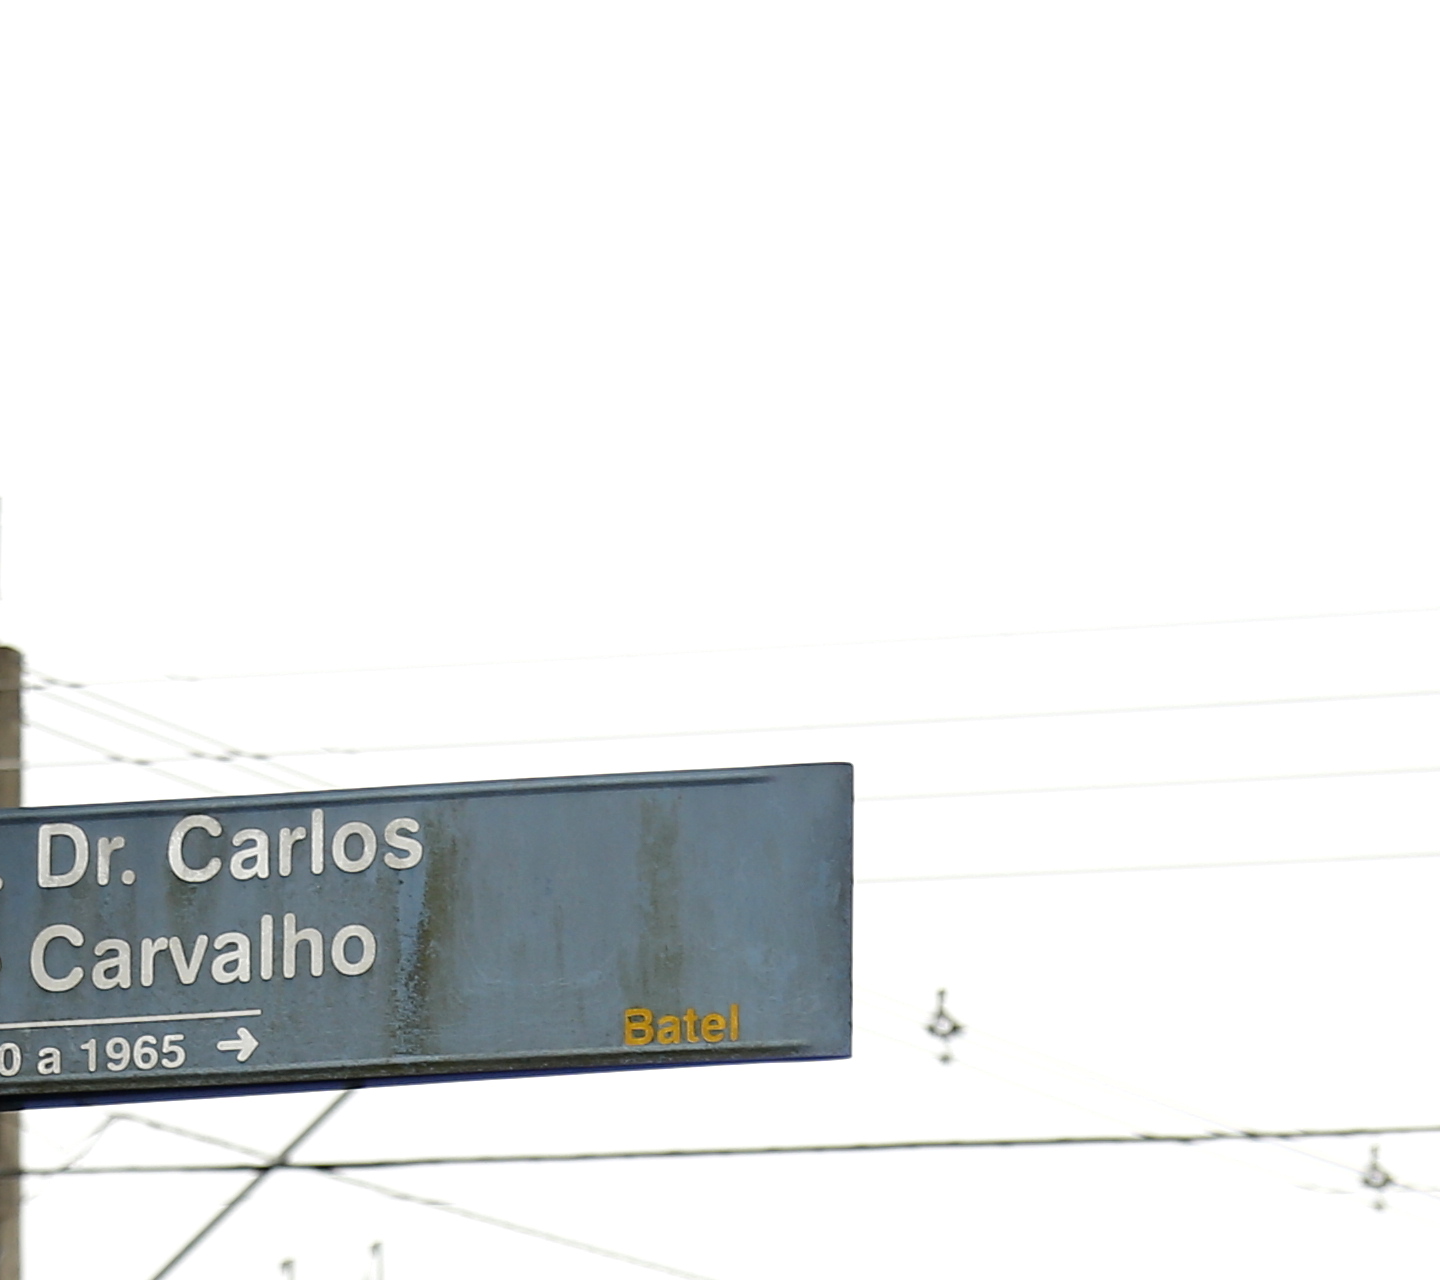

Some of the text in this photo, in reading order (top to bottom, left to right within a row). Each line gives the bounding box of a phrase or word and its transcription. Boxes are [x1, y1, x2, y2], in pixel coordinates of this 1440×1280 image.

[36, 822, 137, 890] Dr.
[166, 807, 425, 884] Carlos
[29, 911, 378, 993] Carvalho
[36, 1045, 63, 1076] a
[80, 1033, 187, 1073] 1965
[624, 1002, 740, 1046] Batel
